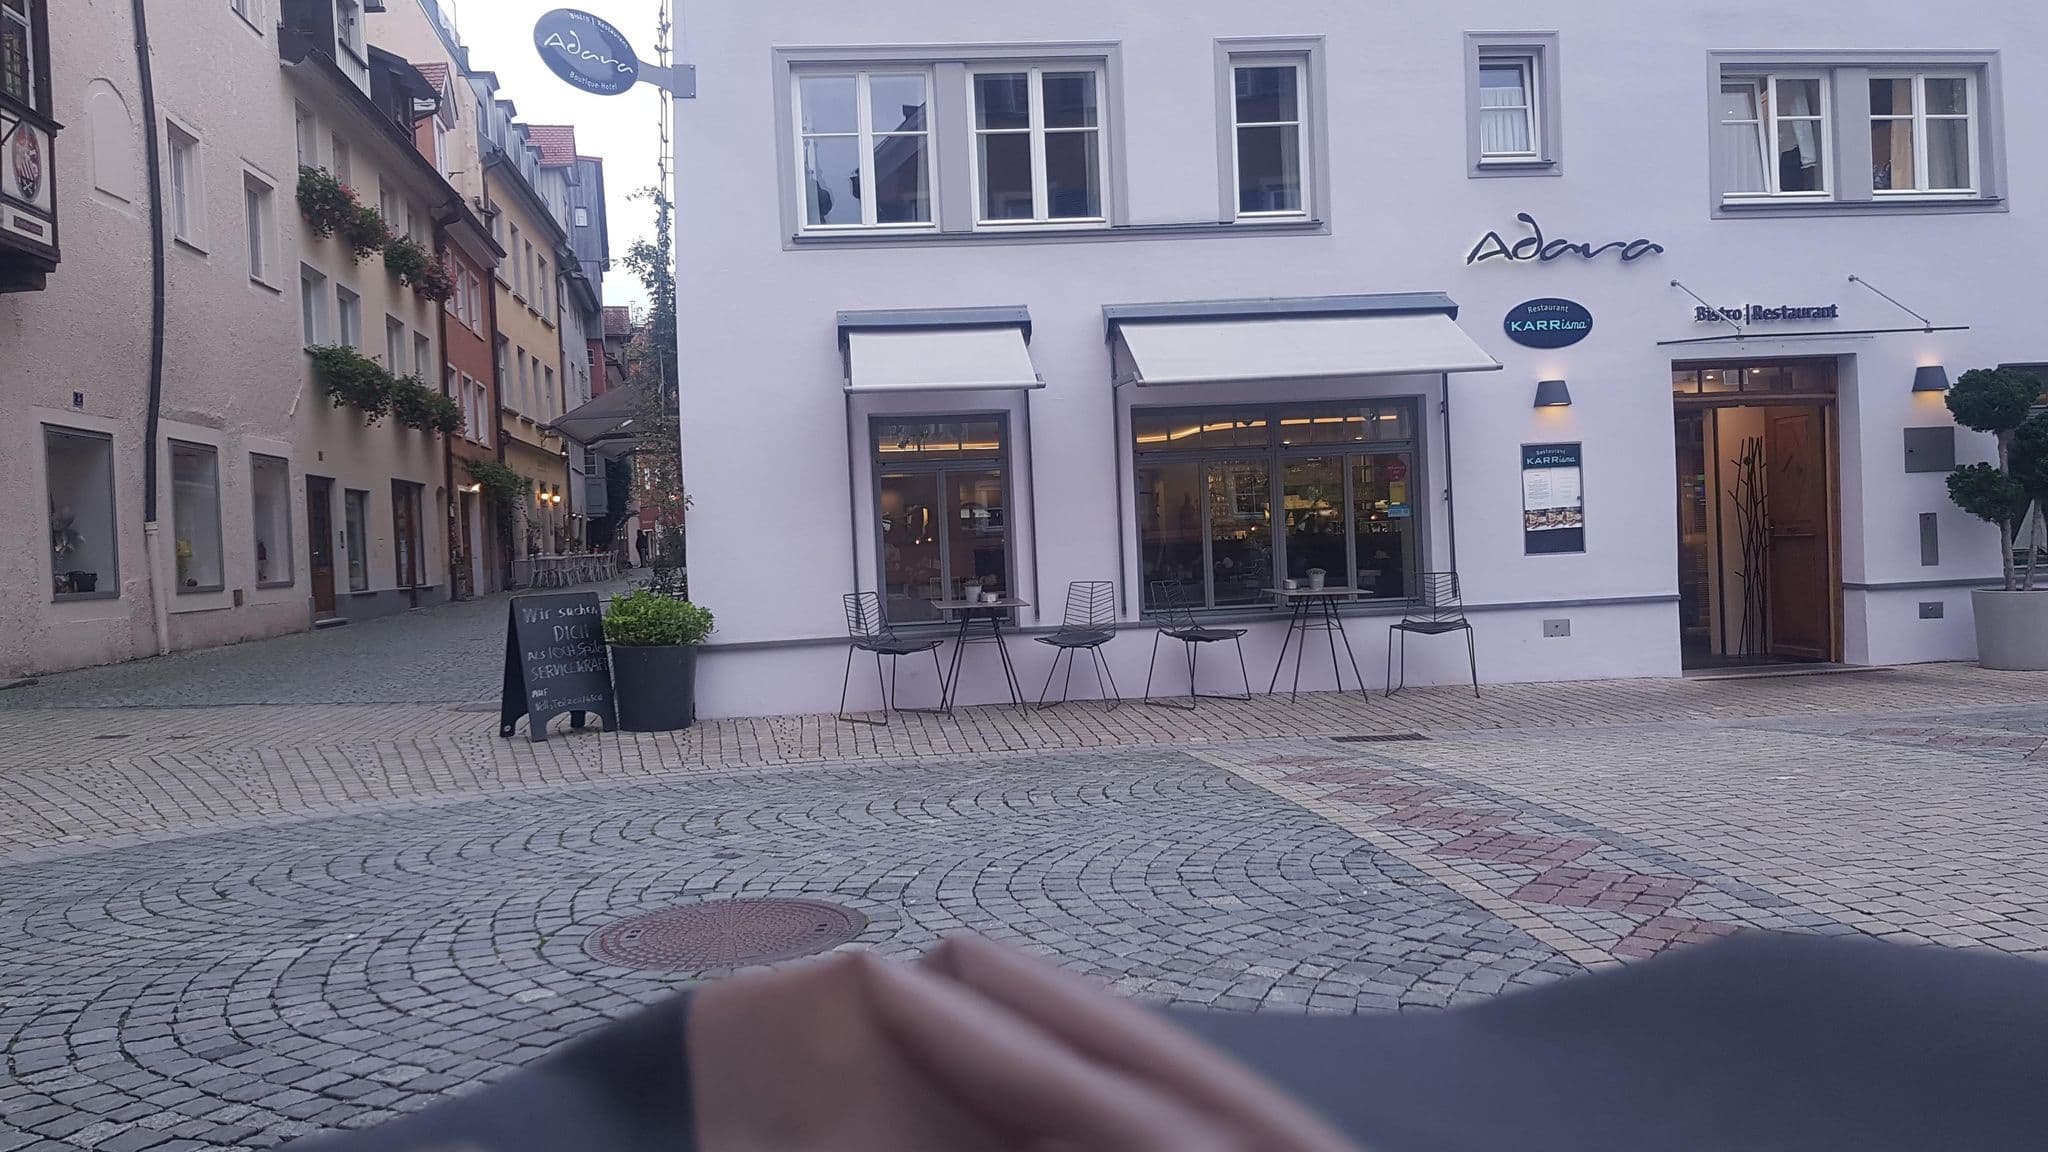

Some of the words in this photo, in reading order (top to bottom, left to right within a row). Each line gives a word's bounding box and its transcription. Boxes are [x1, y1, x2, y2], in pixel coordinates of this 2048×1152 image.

[543, 30, 634, 74] Adara
[1466, 212, 1664, 265] Adara
[1527, 305, 1569, 313] Restaurant
[1695, 305, 1742, 321] Bistro
[1751, 303, 1839, 320] Restaurant
[1511, 318, 1587, 331] KARRisma
[521, 607, 551, 623] Wir
[553, 623, 590, 642] DICH
